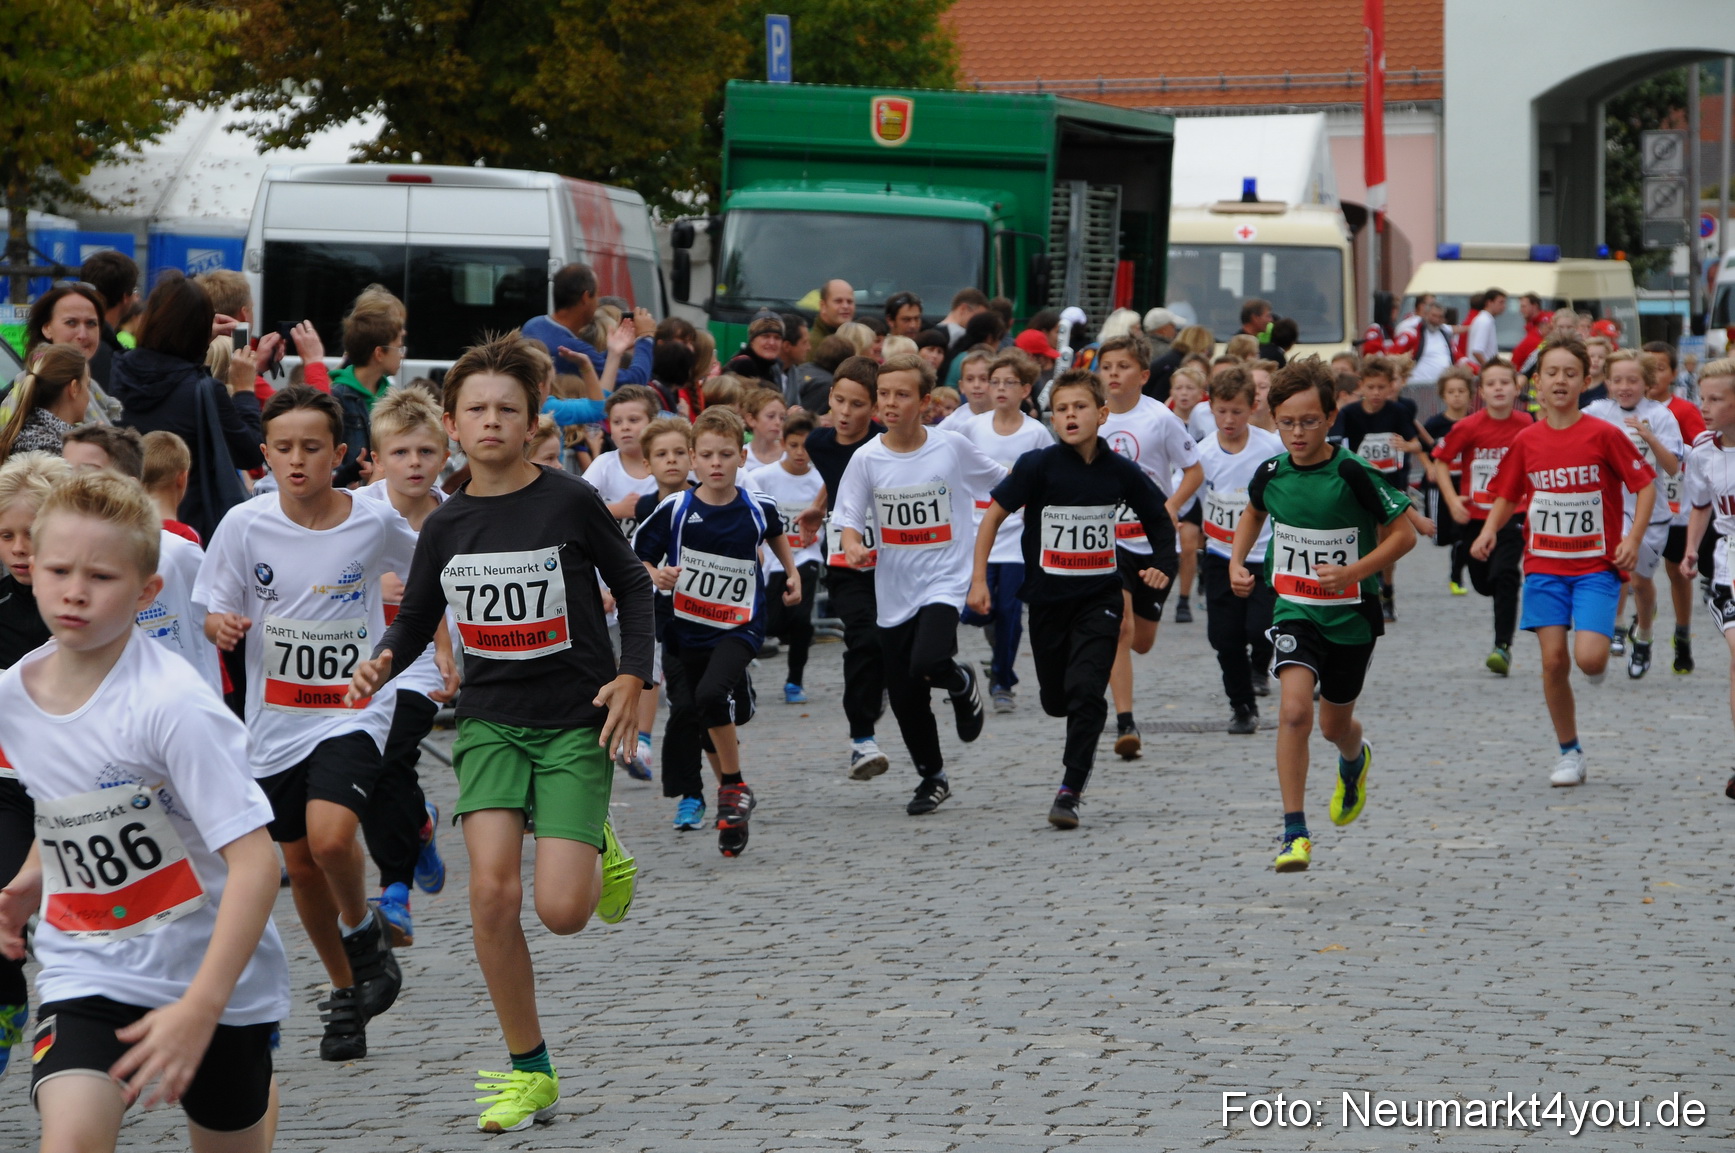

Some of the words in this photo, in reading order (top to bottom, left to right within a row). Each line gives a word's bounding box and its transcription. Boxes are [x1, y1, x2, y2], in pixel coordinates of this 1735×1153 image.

[772, 24, 785, 73] P
[1528, 464, 1601, 490] MEISTER
[874, 492, 898, 501] PARTL
[899, 489, 936, 500] Neumarkt
[1554, 499, 1589, 507] Neumarkt
[882, 498, 940, 526] 7061
[1043, 511, 1069, 520] PARTL
[1072, 513, 1106, 521] Neumarkt
[1207, 501, 1244, 529] 731
[1537, 509, 1595, 534] 7178
[900, 531, 931, 543] David
[1051, 524, 1108, 550] 7163
[1276, 530, 1300, 543] PARTL
[1301, 536, 1343, 546] Neumarkt
[1540, 537, 1596, 550] Maximilian
[443, 566, 480, 577] PARTL
[483, 563, 540, 576] Neumarkt
[708, 562, 746, 575] Neumarkt
[1050, 553, 1110, 567] Maximilian
[685, 567, 748, 603] 7079
[455, 579, 549, 622] 7207
[684, 599, 736, 622] Christoph
[266, 624, 299, 640] PARTL
[302, 630, 353, 641] Neumarkt
[476, 630, 548, 648] Jonathan
[275, 641, 360, 681] 7062
[294, 689, 341, 705] Jonas
[56, 806, 126, 829] Neumarkt
[42, 821, 162, 890] 7386
